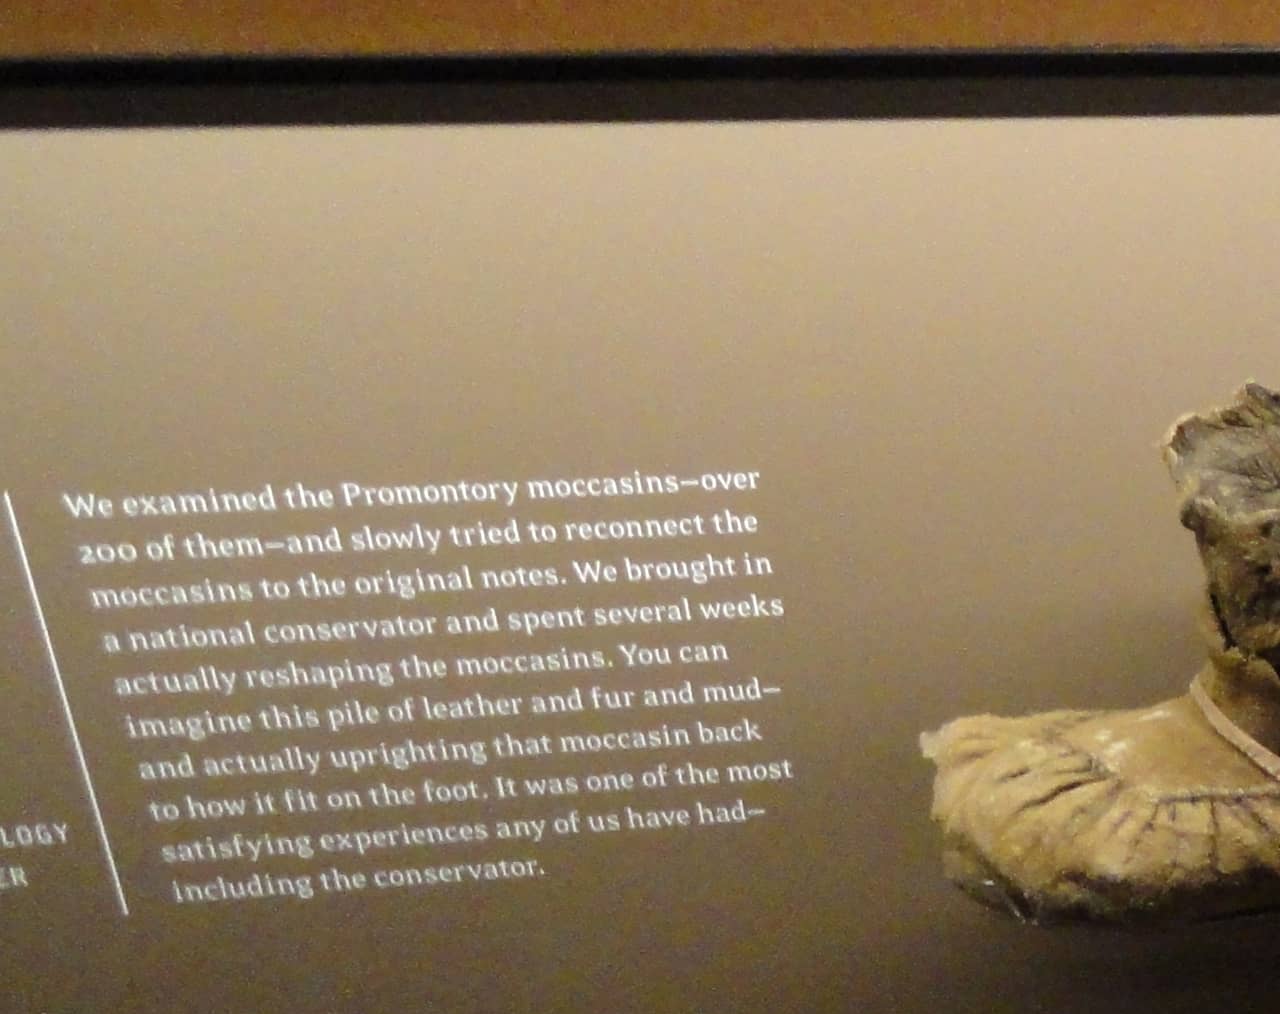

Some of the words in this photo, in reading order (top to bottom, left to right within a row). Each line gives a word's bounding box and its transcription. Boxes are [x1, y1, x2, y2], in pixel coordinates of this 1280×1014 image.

[62, 493, 112, 517] We
[122, 484, 276, 514] examined
[284, 482, 333, 508] the
[341, 481, 517, 506] Promontory
[81, 543, 137, 563] 200
[145, 533, 174, 560] of
[351, 523, 440, 553] slowly
[449, 518, 520, 546] tried
[527, 521, 557, 542] to
[564, 515, 703, 540] reconnect
[711, 508, 757, 534] the
[92, 578, 252, 606] moccasins
[259, 579, 290, 598] to
[297, 572, 345, 596] the
[354, 565, 472, 598] original
[481, 567, 566, 588] notes.
[572, 559, 617, 583] We
[624, 553, 736, 584] brought
[743, 551, 773, 575] in
[103, 634, 120, 652] a
[129, 620, 254, 650] national
[264, 616, 436, 642] conservator
[446, 607, 499, 633] and
[507, 606, 584, 635] spent
[593, 597, 691, 625] several
[699, 593, 784, 619] weeks
[116, 665, 235, 694] actually
[246, 659, 393, 688] reshaping
[399, 654, 446, 678] the
[456, 647, 612, 675] moccasins.
[618, 643, 671, 666] You
[678, 644, 728, 663] can
[127, 710, 251, 740] imagine
[258, 704, 319, 729] this
[328, 700, 378, 731] pile
[387, 697, 413, 721] of
[422, 693, 522, 718] leather
[531, 687, 583, 712] and
[590, 685, 635, 709] fur
[643, 680, 694, 706] and
[139, 753, 194, 779] and
[204, 746, 319, 775] actually
[330, 738, 487, 771] uprighting
[492, 732, 552, 756] that
[560, 724, 690, 752] moccasin
[696, 717, 762, 743] back
[149, 802, 179, 821] to
[185, 795, 245, 818] how
[254, 791, 274, 814] it
[284, 788, 317, 812] fit
[326, 791, 362, 807] on
[368, 782, 415, 805] the
[423, 779, 488, 802] foot.
[495, 775, 517, 798] It
[524, 776, 578, 795] was
[585, 773, 633, 792] one
[641, 763, 667, 787] of
[674, 761, 719, 785] the
[726, 759, 792, 782] most
[0, 822, 68, 849] LOGY
[162, 833, 313, 861] satisfying
[319, 823, 488, 854] experiences
[495, 819, 545, 841] any
[553, 809, 580, 833] of
[587, 813, 620, 832] us
[626, 806, 689, 829] have
[172, 873, 313, 902] including
[319, 867, 366, 890] the
[374, 859, 544, 886] conservator.
